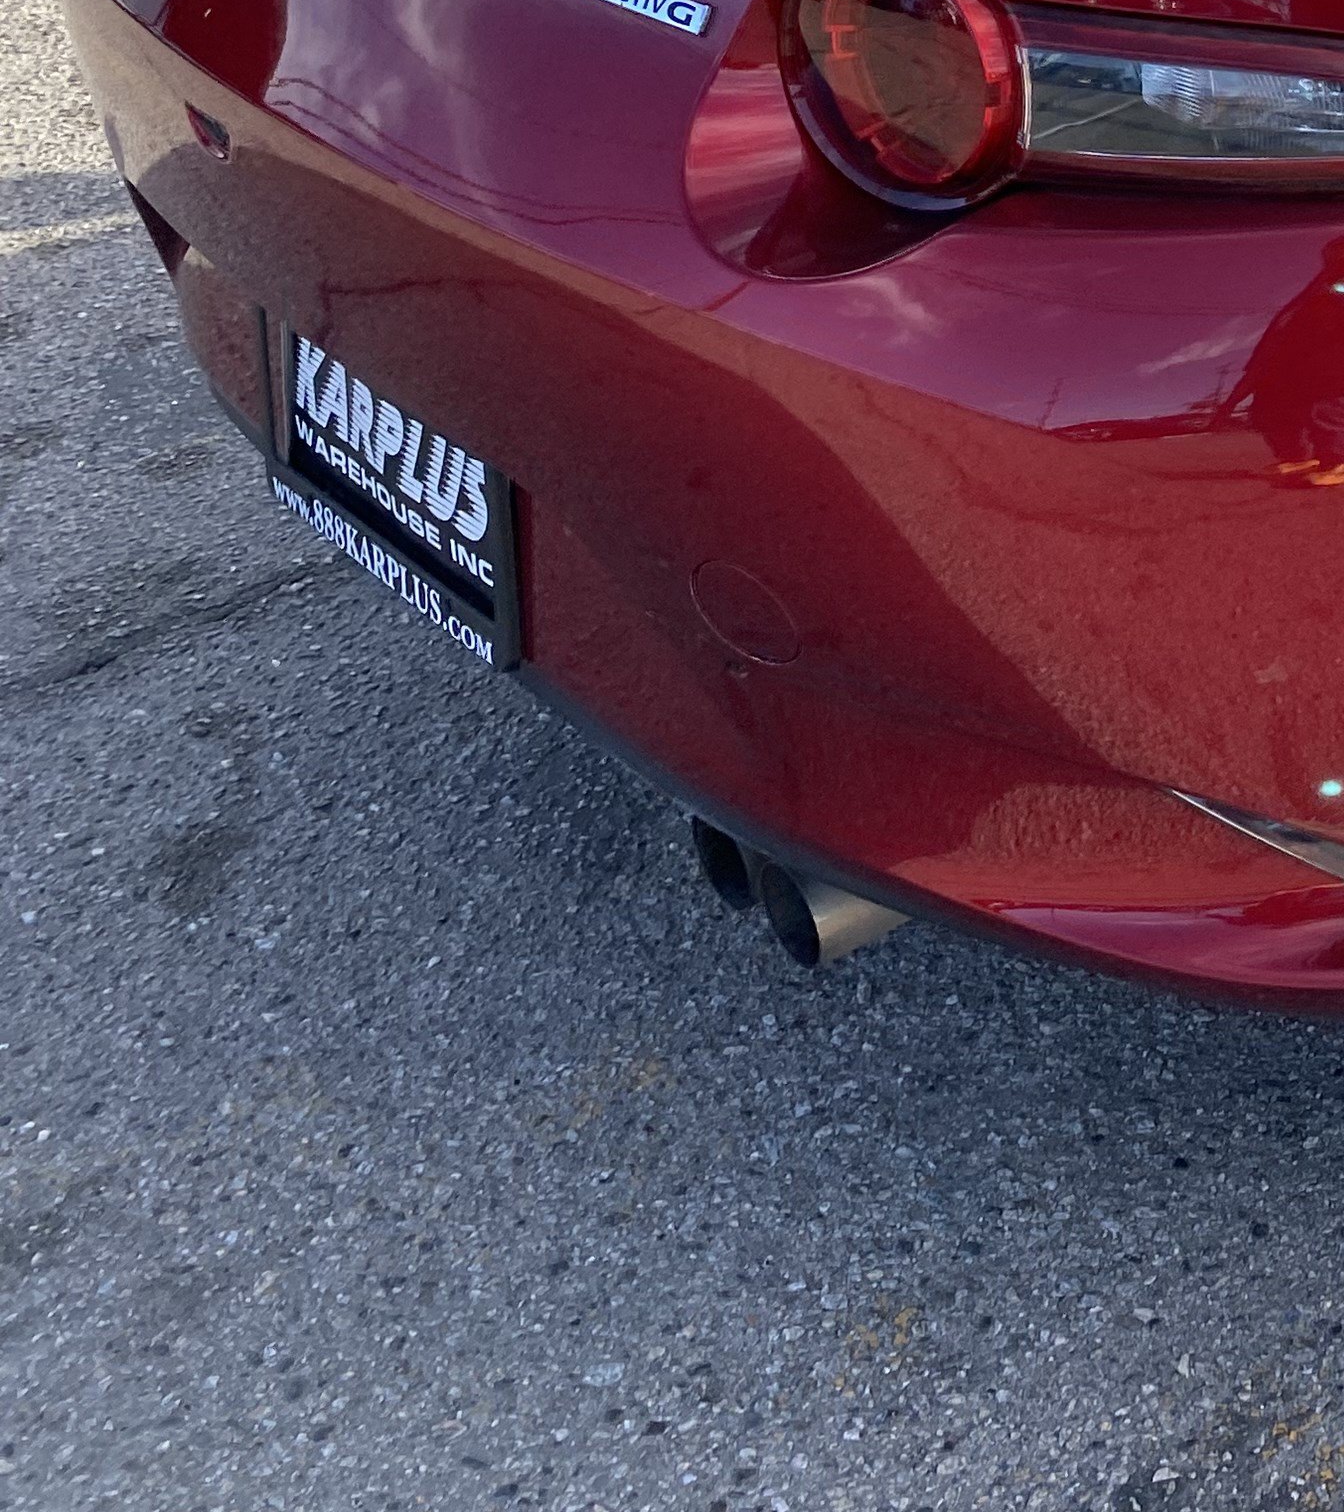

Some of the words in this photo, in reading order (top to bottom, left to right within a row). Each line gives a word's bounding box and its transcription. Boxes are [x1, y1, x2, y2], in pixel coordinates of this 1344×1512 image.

[294, 414, 442, 551] WAREHOUSE
[449, 537, 495, 588] INC
[296, 336, 488, 542] KARPLUS
